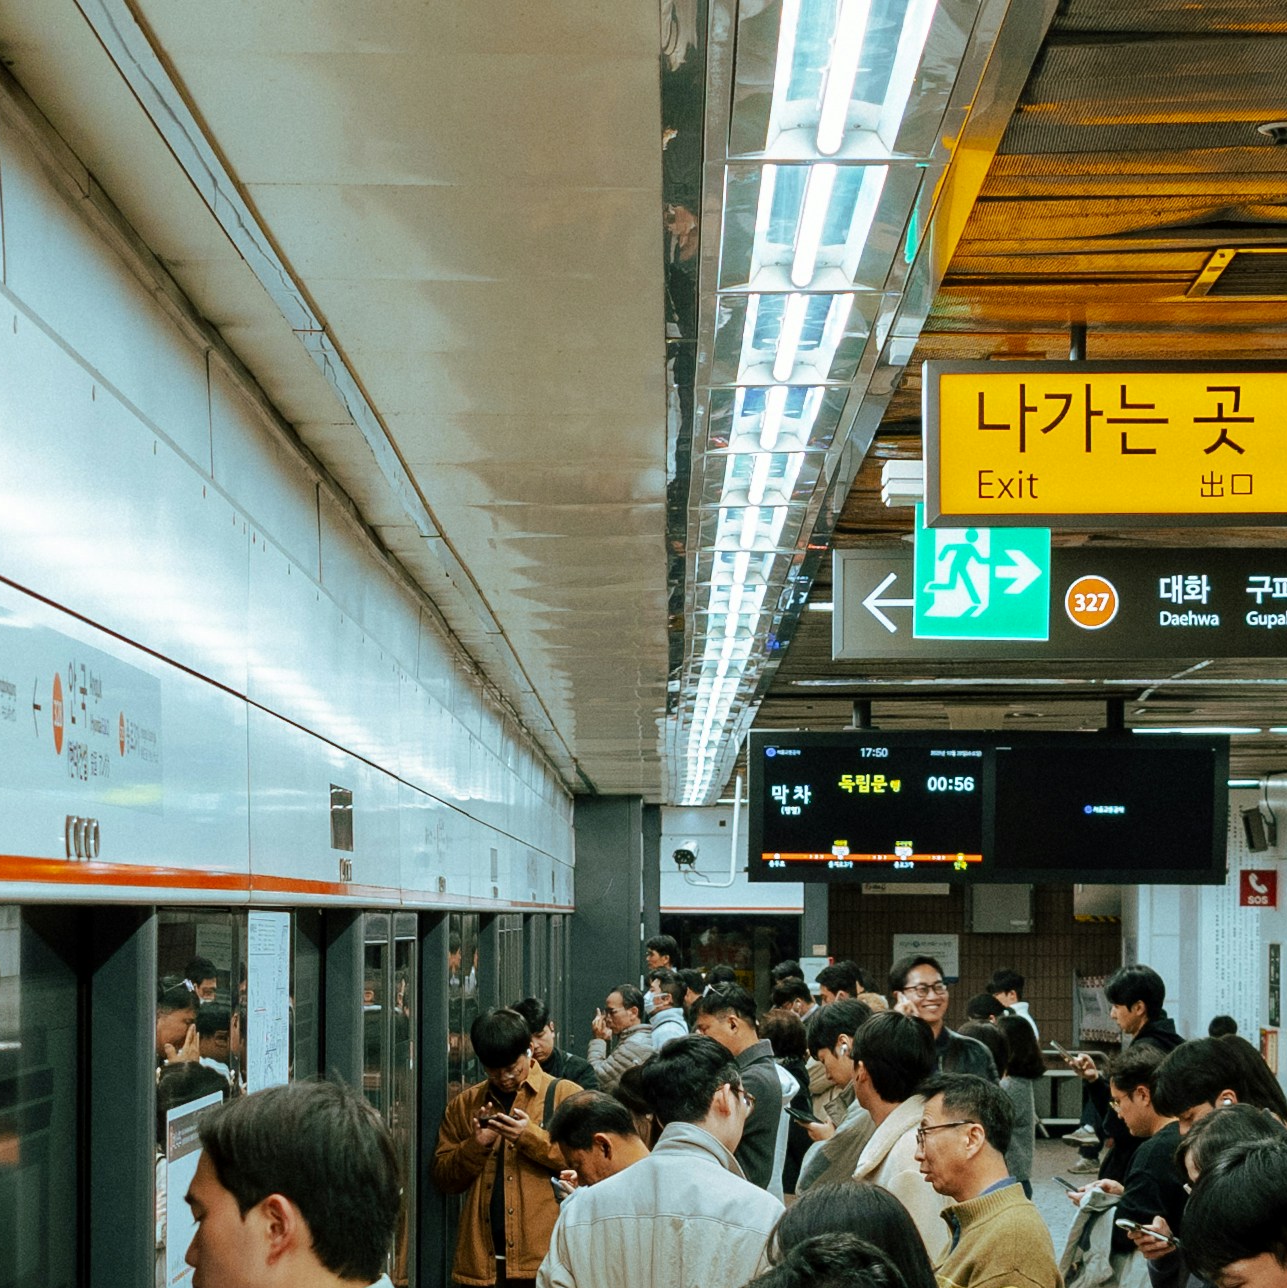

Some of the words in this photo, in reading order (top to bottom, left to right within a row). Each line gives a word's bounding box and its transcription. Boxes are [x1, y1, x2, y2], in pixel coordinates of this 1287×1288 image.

[978, 383, 1169, 455] 나가는
[1193, 386, 1255, 455] 곳
[978, 470, 1038, 499] Exit
[1200, 471, 1253, 498] 出口
[1159, 574, 1211, 605] 대화
[1073, 589, 1110, 615] 327
[1159, 610, 1220, 627] Daehwa
[860, 747, 889, 758] 17:50
[838, 773, 887, 794] 독립문
[926, 775, 975, 792] 00:56
[1247, 895, 1269, 905] SOS
